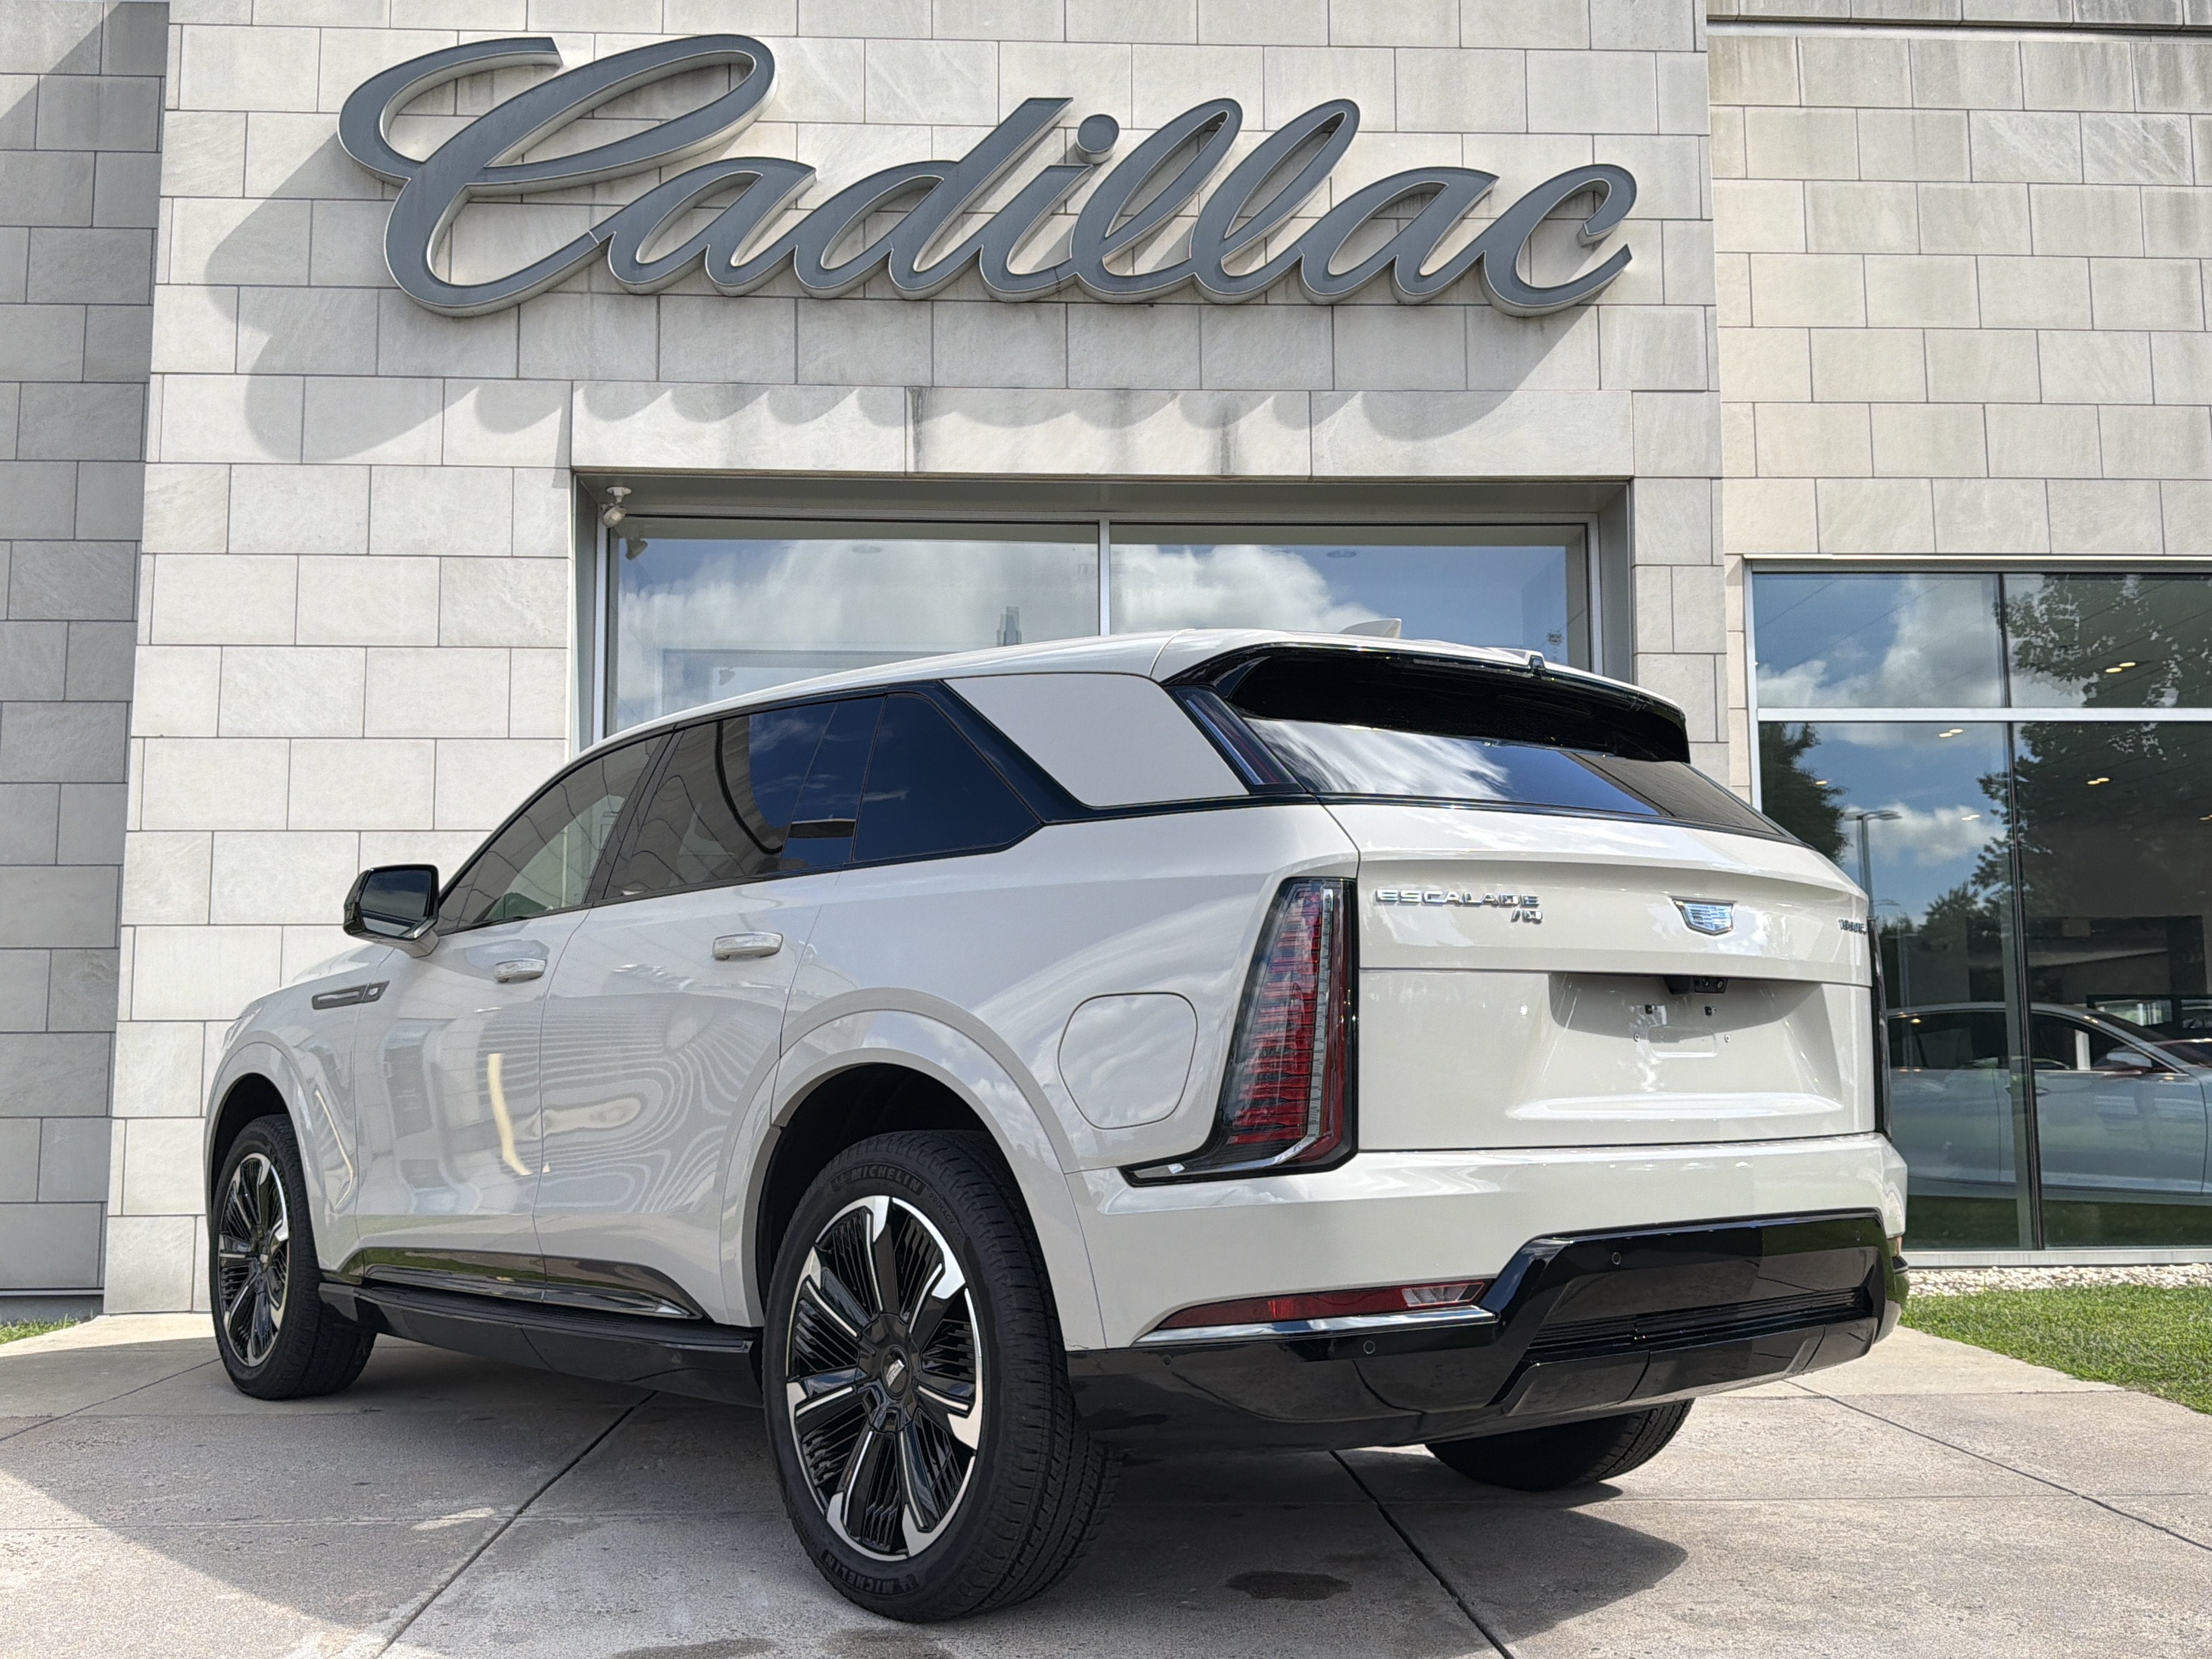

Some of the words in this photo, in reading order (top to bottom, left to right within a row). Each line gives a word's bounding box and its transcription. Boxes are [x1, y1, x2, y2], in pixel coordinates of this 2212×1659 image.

[337, 33, 1637, 317] Cadillac
[1376, 889, 1540, 907] ESCALADE
[851, 1164, 921, 1192] MICHELIN
[928, 1193, 955, 1224] PRIMACY
[825, 1554, 894, 1594] MICHELIN
